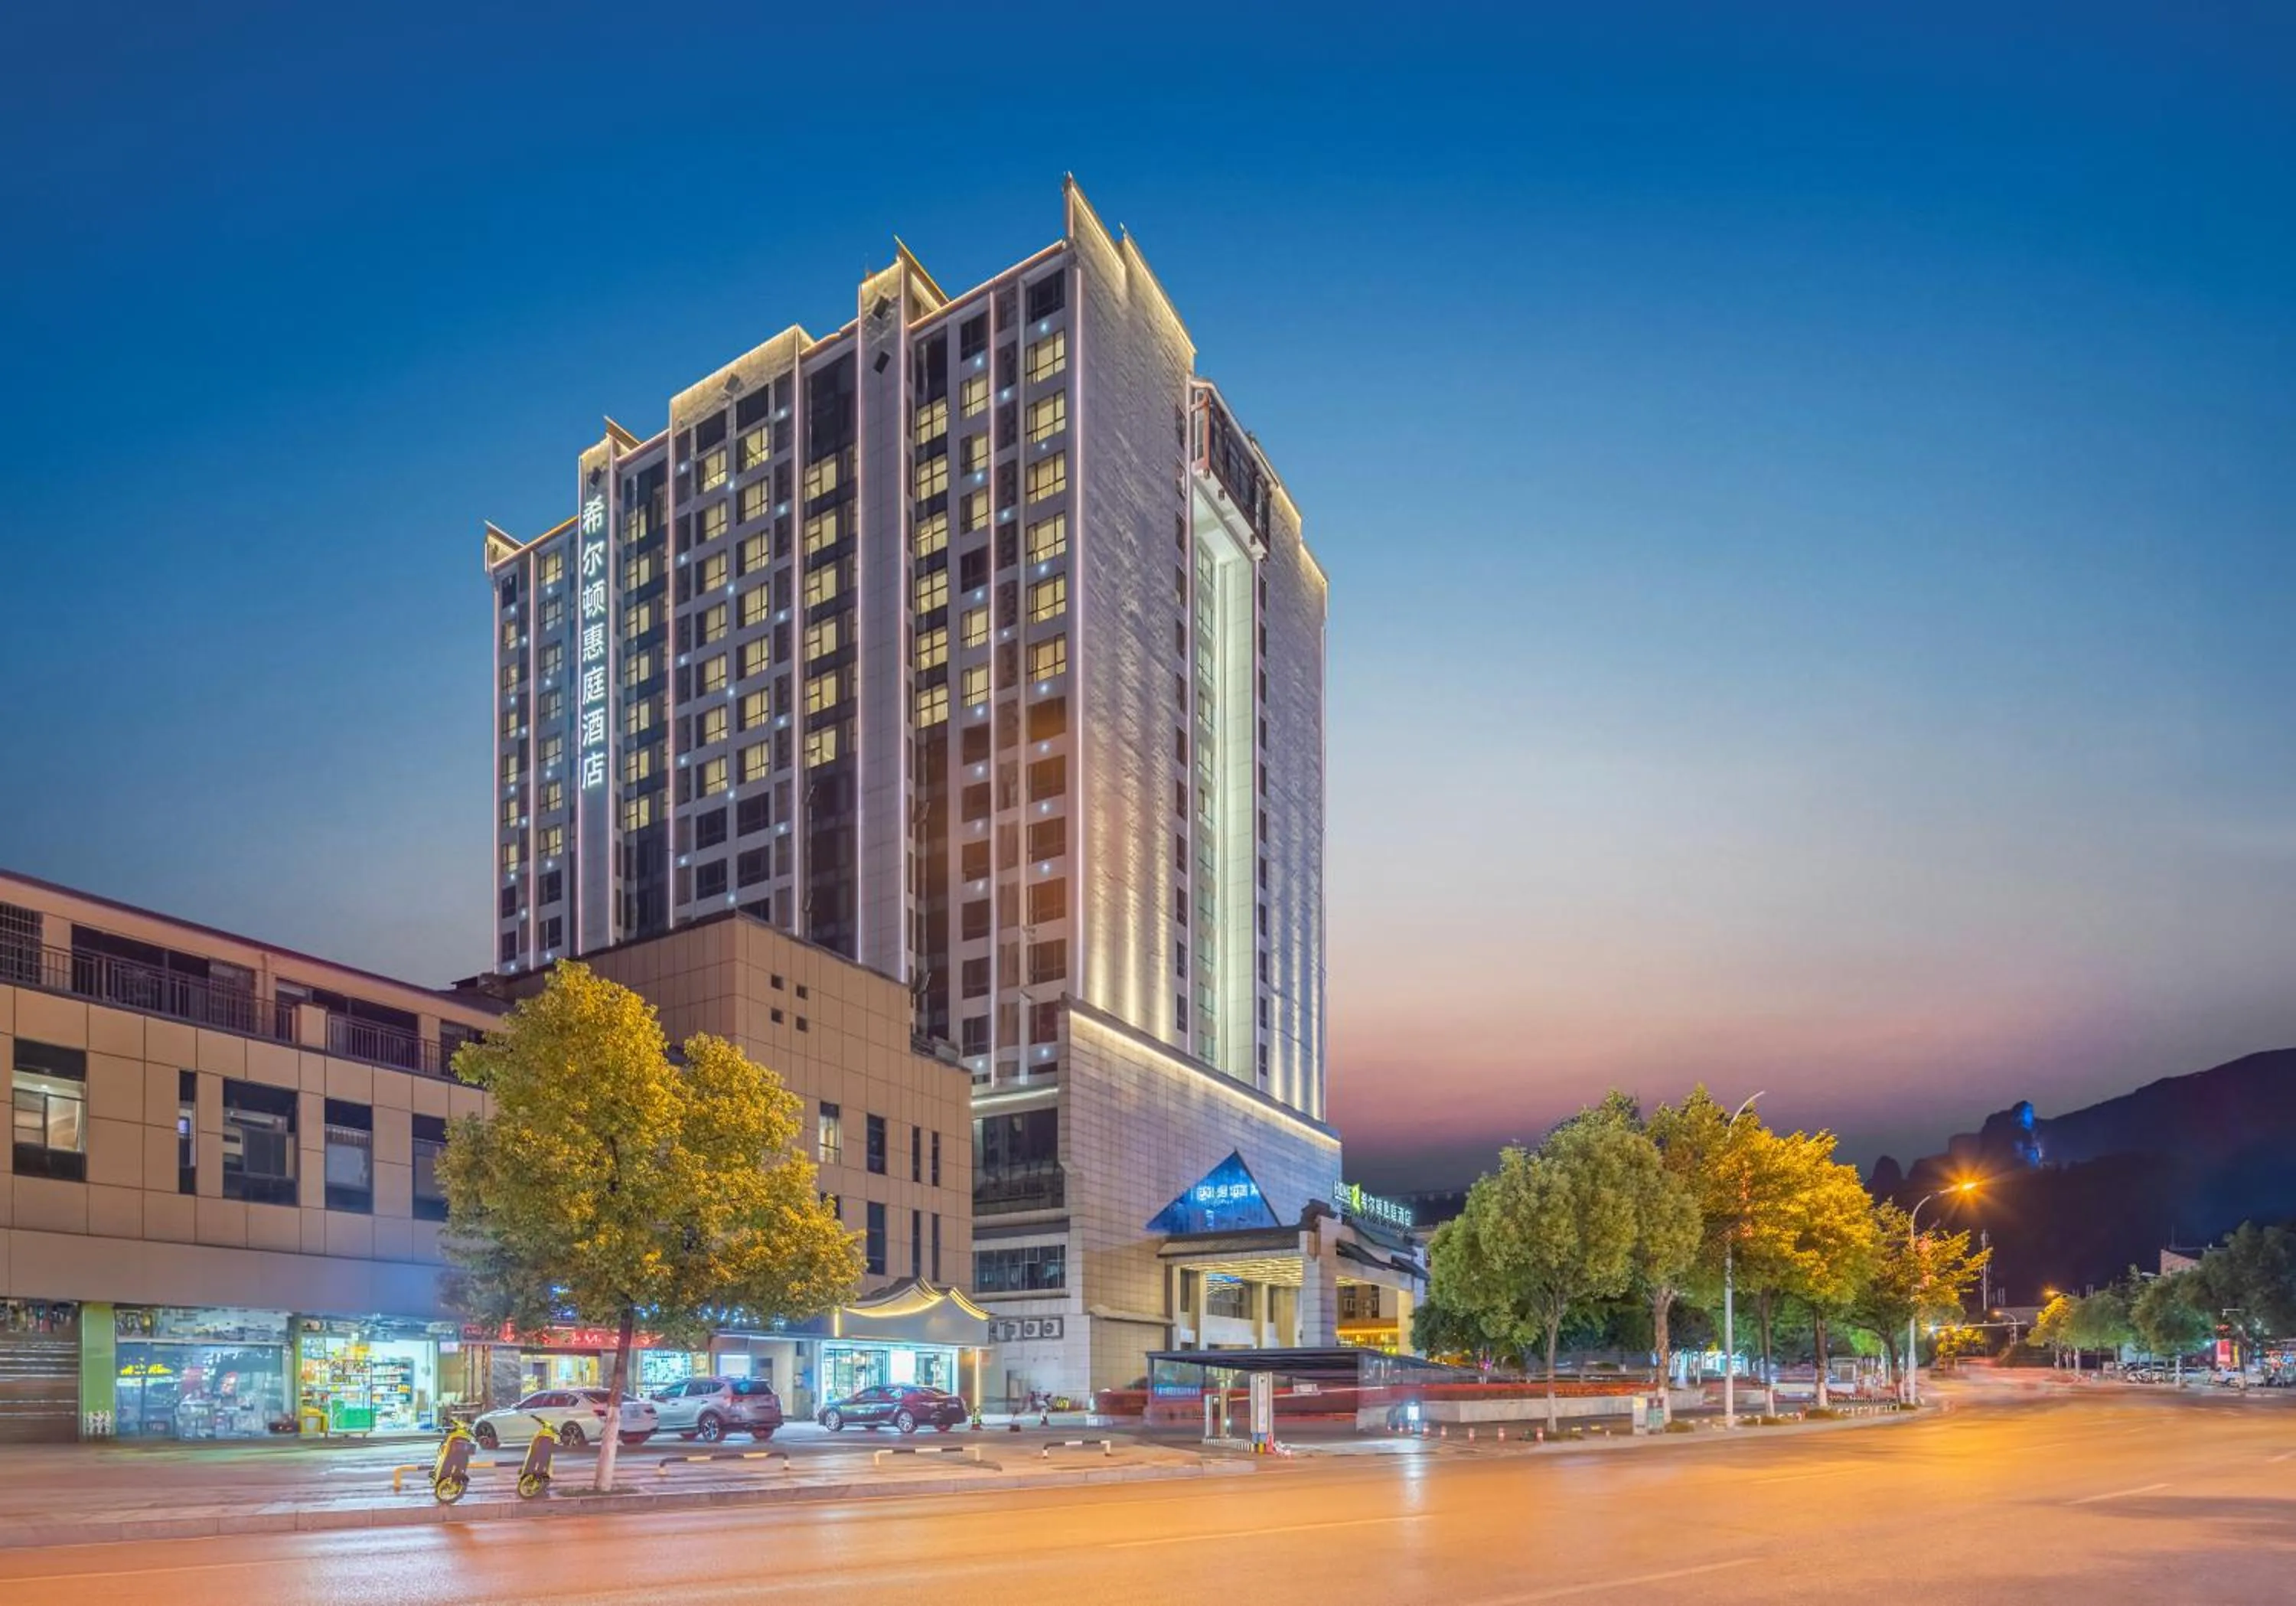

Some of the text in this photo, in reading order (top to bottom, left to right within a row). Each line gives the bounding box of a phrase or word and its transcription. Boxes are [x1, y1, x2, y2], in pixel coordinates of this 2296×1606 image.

[582, 494, 605, 790] 希尔顿惠庭酒店
